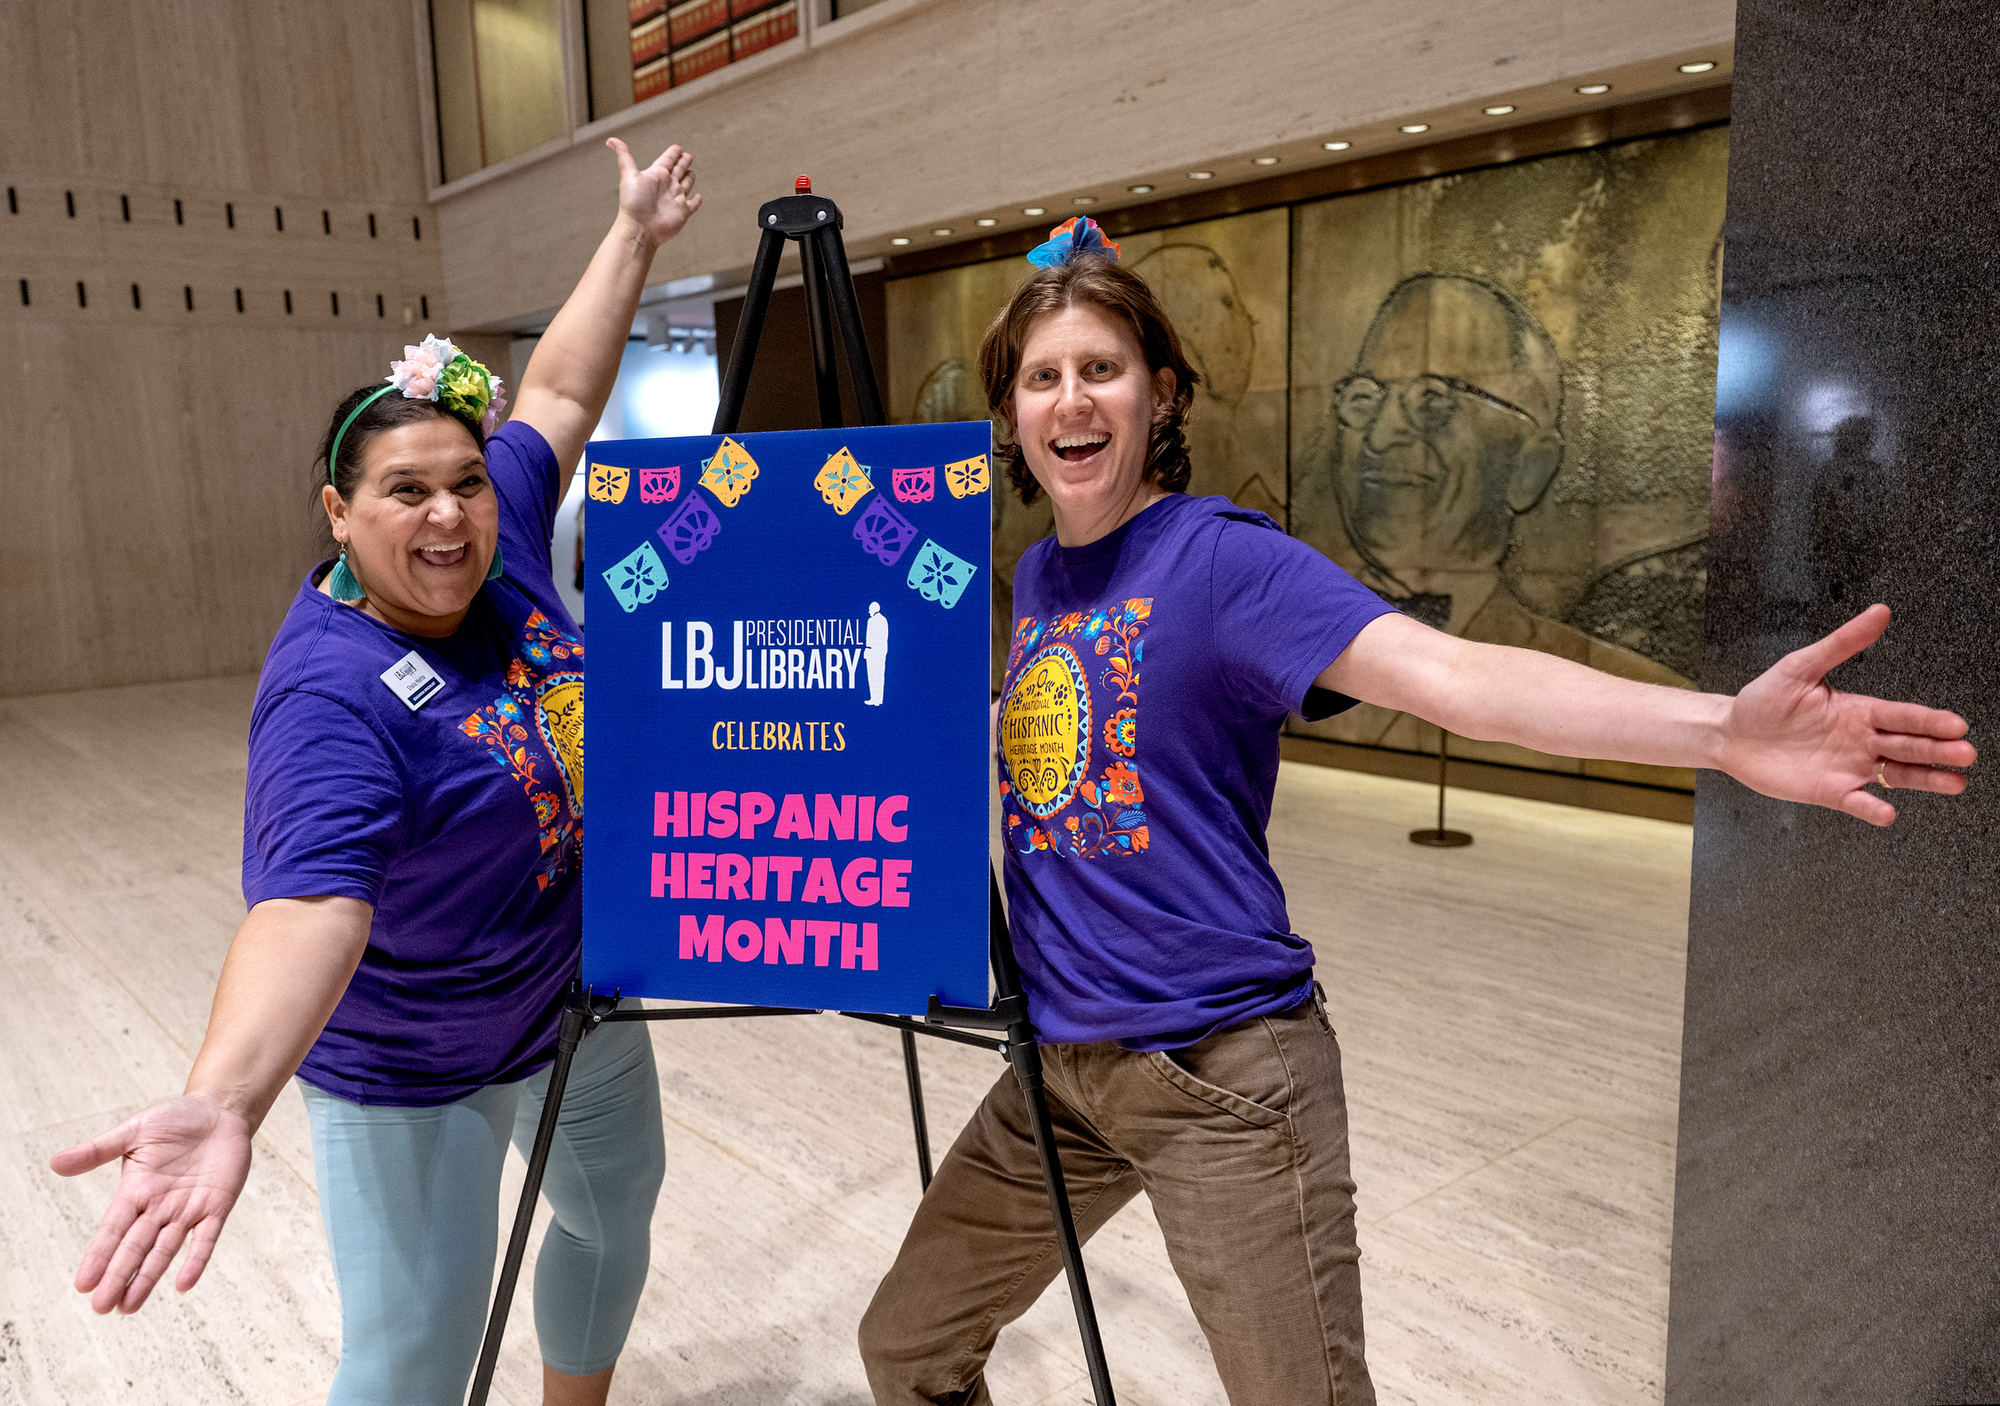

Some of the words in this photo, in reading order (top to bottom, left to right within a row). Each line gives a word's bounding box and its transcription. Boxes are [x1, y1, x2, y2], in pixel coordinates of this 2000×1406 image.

[746, 619, 864, 646] PRESIDENTIAL
[662, 621, 743, 690] LBJ
[746, 649, 862, 689] LIBRARY
[1022, 699, 1050, 711] NATIONAL
[712, 721, 846, 751] CELEBRATES
[1010, 713, 1064, 739] HISPANIC
[1010, 743, 1038, 756] HERITAGE
[1040, 742, 1065, 753] MONTH
[653, 790, 909, 843] HISPANIC
[650, 852, 912, 908] HERITAGE
[679, 914, 878, 971] MONTH
